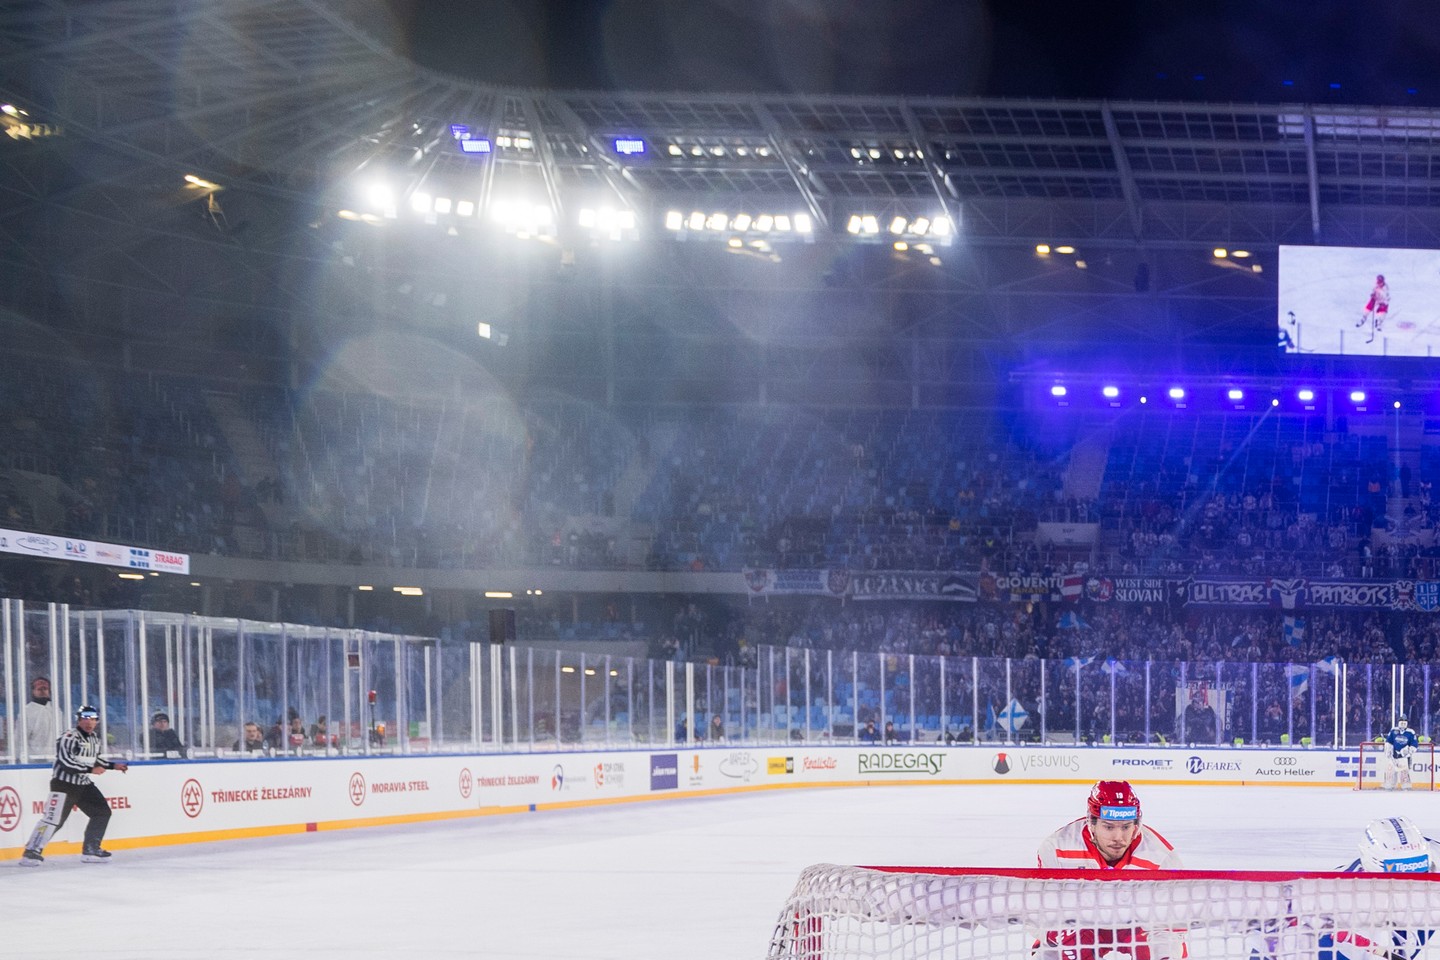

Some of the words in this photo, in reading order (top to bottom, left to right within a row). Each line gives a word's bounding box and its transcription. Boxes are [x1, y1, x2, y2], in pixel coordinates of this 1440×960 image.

[154, 553, 184, 566] STRABAG
[1115, 579, 1141, 589] WEST
[1144, 579, 1164, 589] SIDE
[1115, 590, 1163, 601] SLOVAN
[1193, 584, 1265, 602] ULTRAS
[1311, 585, 1390, 604] PATRIOTS
[858, 753, 947, 775] RADEGAST
[1020, 754, 1080, 772] VESUVIUS
[1112, 759, 1174, 767] PROMET
[1255, 768, 1281, 776] Auto
[1284, 768, 1315, 776] Heller
[371, 783, 407, 793] MORAVIA
[408, 781, 430, 791] STEEL
[477, 777, 506, 788] TŘINECKÉ
[507, 775, 540, 786] ŽELEZÁRNY
[212, 787, 258, 803] TŘINECKÉ
[261, 786, 313, 801] ŽELEZÁRNY
[1109, 809, 1136, 818] Tipsport
[1395, 859, 1428, 871] Tipsport
